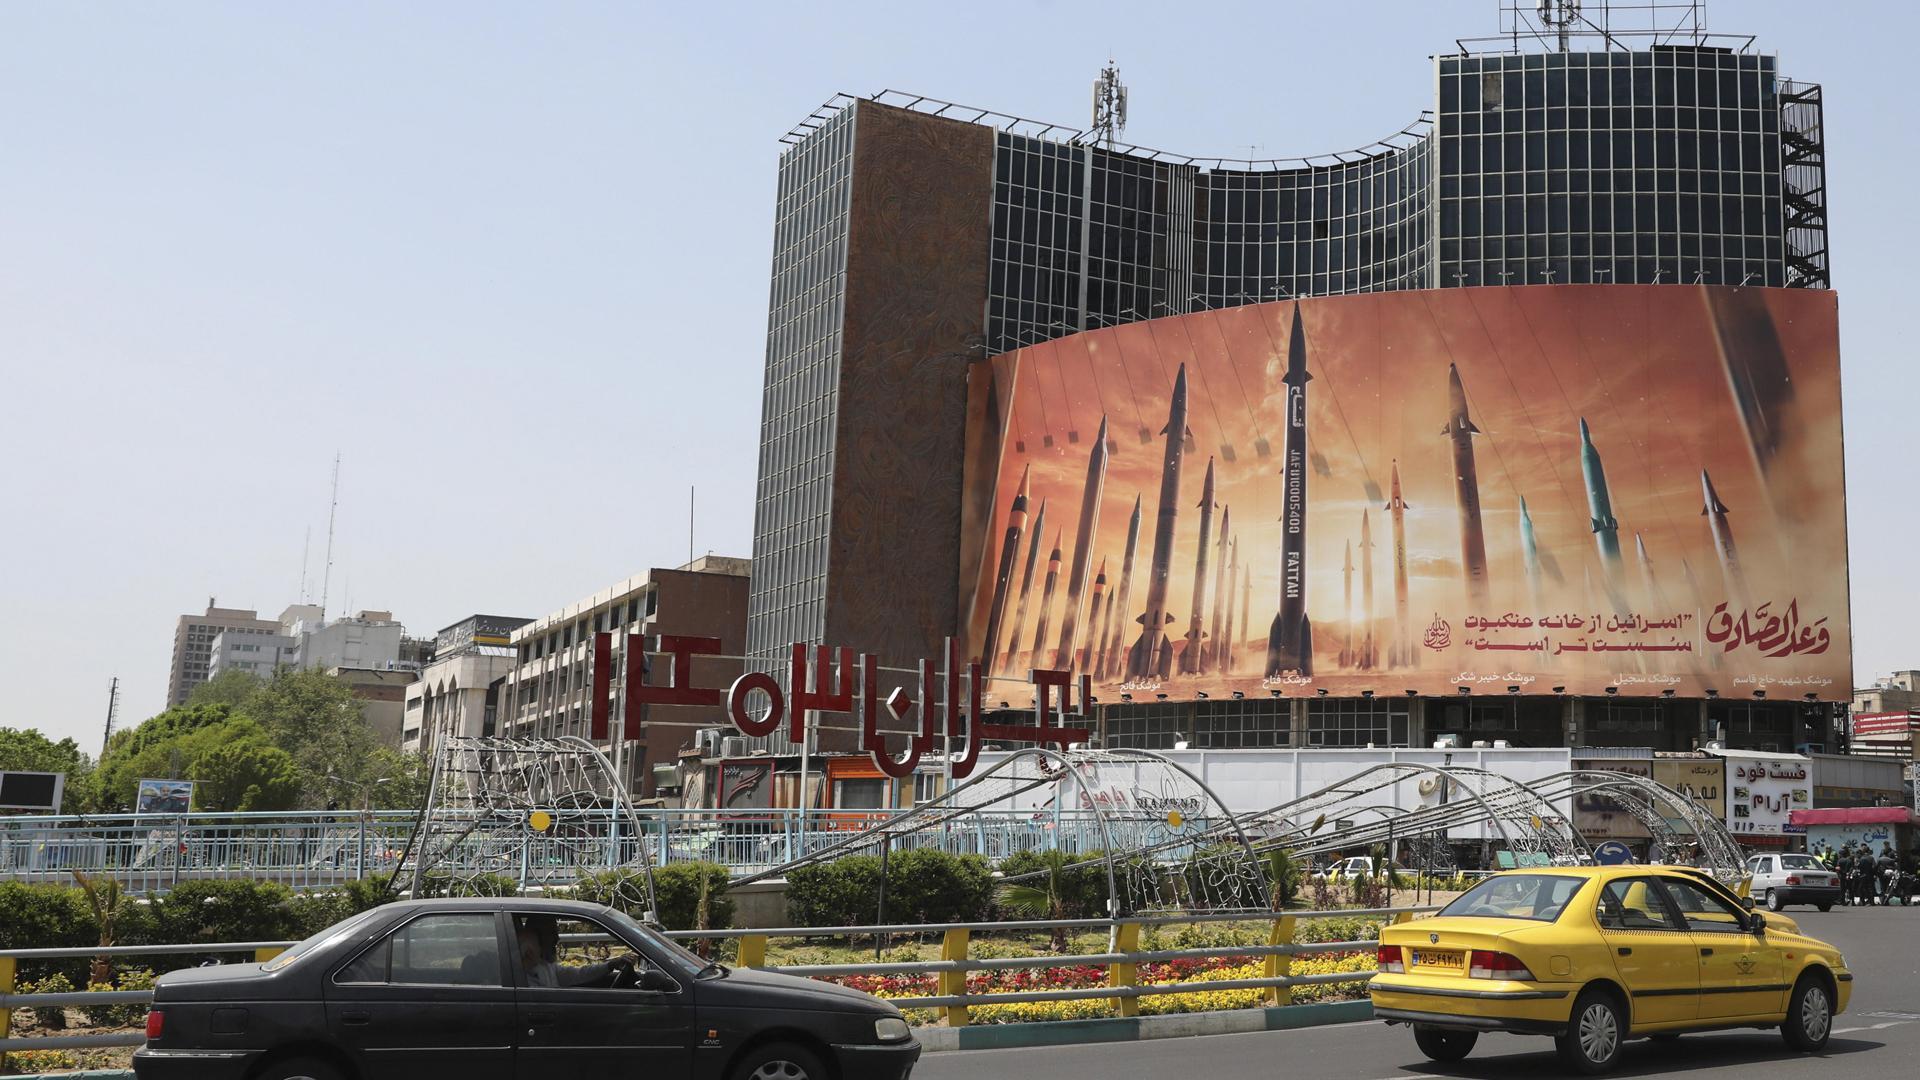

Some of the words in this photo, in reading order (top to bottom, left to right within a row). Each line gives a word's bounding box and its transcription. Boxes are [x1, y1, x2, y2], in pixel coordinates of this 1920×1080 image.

[1287, 552, 1299, 598] FATTAH
[1464, 611, 1534, 632] عنکبوت
[1538, 613, 1585, 629] خانه
[1588, 613, 1602, 633] از
[1553, 638, 1589, 655] تر
[1262, 674, 1281, 690] فتاح
[1282, 674, 1312, 687] موشک
[1450, 671, 1476, 684] شکن
[1476, 671, 1501, 683] خیبر
[1502, 671, 1536, 685] موشک
[1613, 672, 1646, 686] سجیل
[1647, 673, 1681, 686] موشک
[1732, 673, 1757, 688] قاسم
[1758, 673, 1777, 688] حاج
[1777, 675, 1802, 686] شهید
[1803, 674, 1833, 687] موشک
[1119, 680, 1136, 694] فاتح
[1136, 680, 1161, 692] موشک
[863, 637, 1091, 782] تهران
[1691, 767, 1719, 776] فروشگاه
[1736, 762, 1766, 783] فود
[1769, 763, 1807, 781] فست
[1753, 793, 1791, 813] آرام
[1734, 822, 1755, 832] VIP
